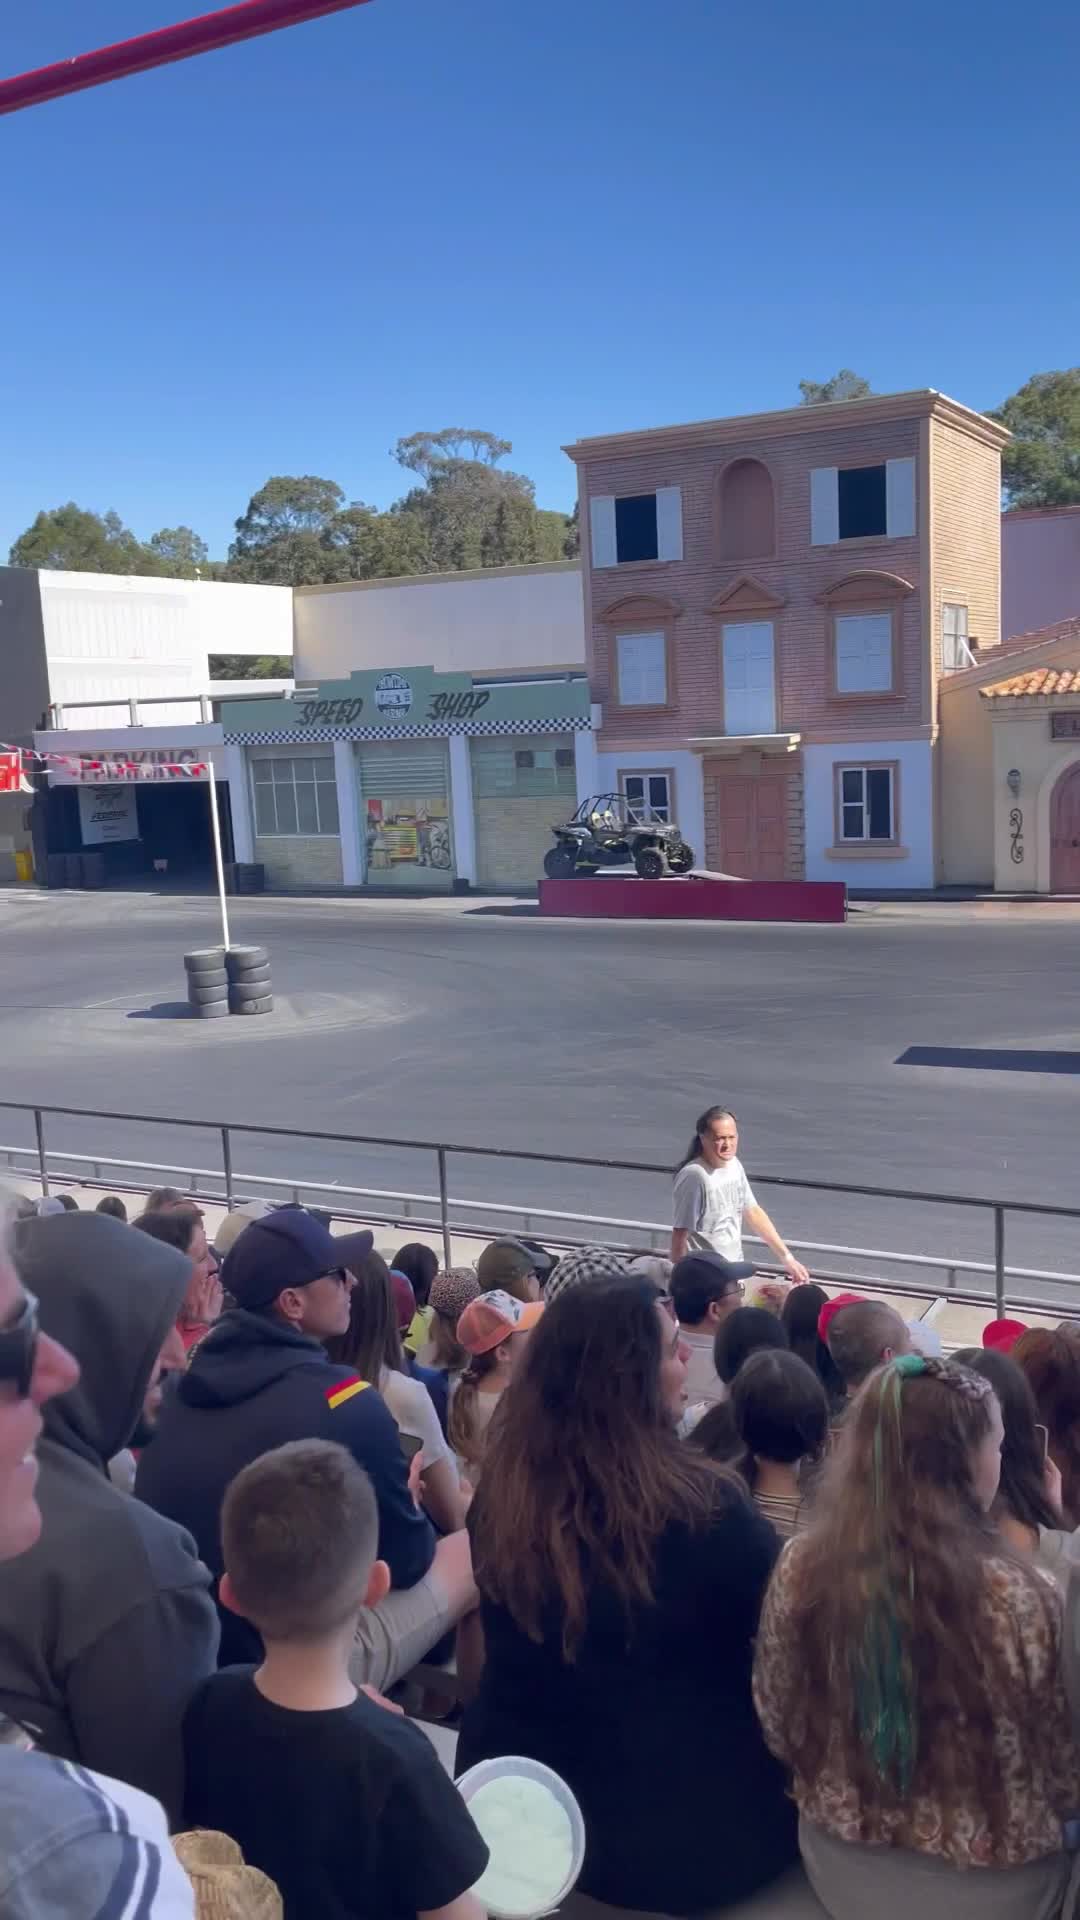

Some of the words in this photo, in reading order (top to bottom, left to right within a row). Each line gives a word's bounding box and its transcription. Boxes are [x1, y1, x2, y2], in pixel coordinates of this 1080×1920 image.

[294, 697, 364, 726] SPEED
[426, 690, 490, 720] SHOP
[79, 749, 200, 779] PARKING
